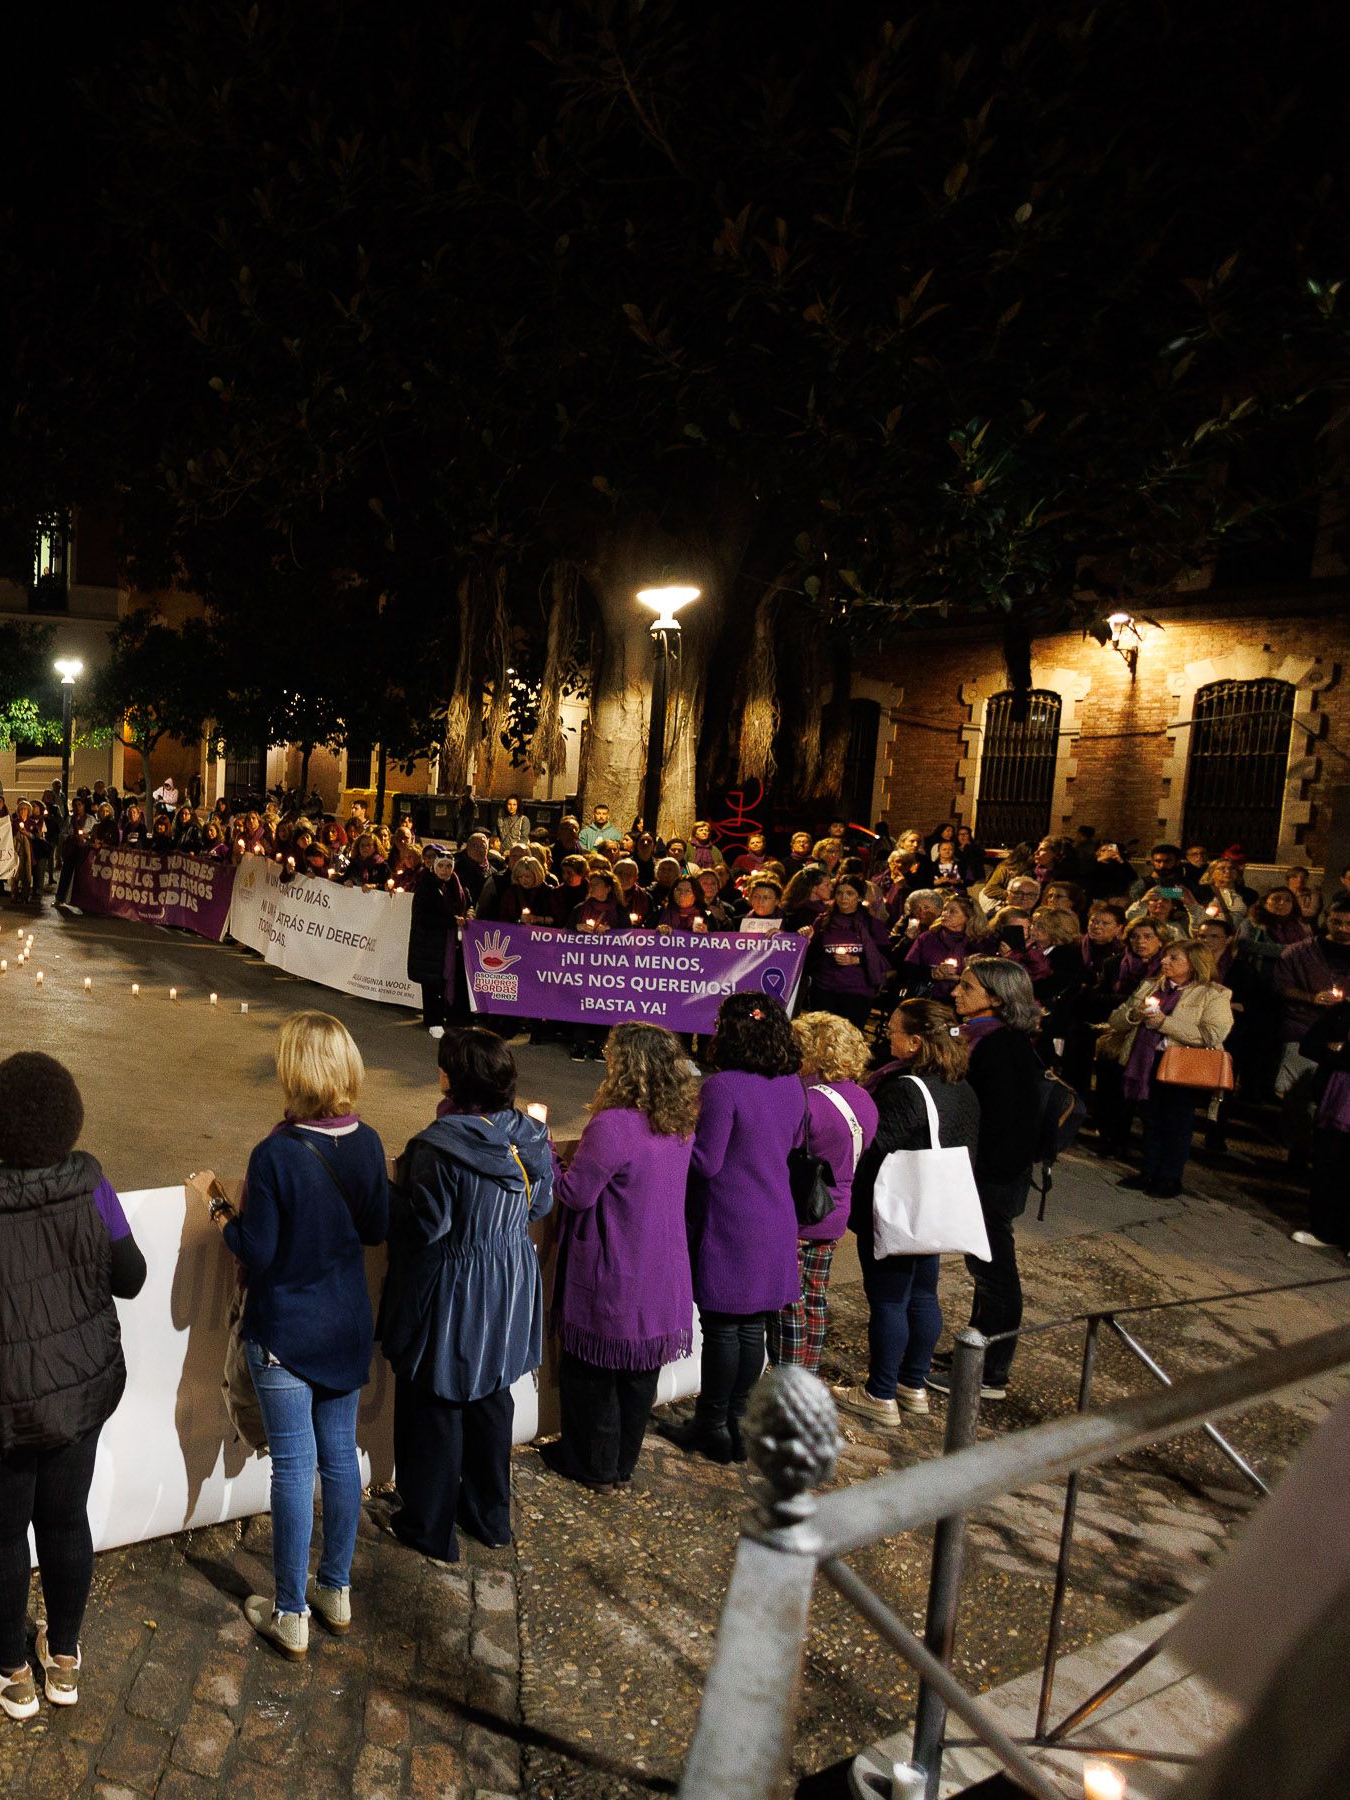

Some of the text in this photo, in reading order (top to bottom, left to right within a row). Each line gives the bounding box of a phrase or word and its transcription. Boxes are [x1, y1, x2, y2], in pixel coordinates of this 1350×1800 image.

[112, 885, 147, 905] TODOS
[304, 890, 330, 909] MÁS.
[276, 913, 304, 932] ATRÁS
[306, 922, 324, 937] EN
[531, 931, 796, 952] NO NECESITAMOS OIR PARA GRITAR:
[561, 952, 704, 973] ¡NI UNA MENOS,
[385, 980, 411, 990] WOOLF
[537, 970, 736, 995] VIVAS NOS QUEREMOS!
[580, 997, 666, 1015] ¡BASTA YA!
